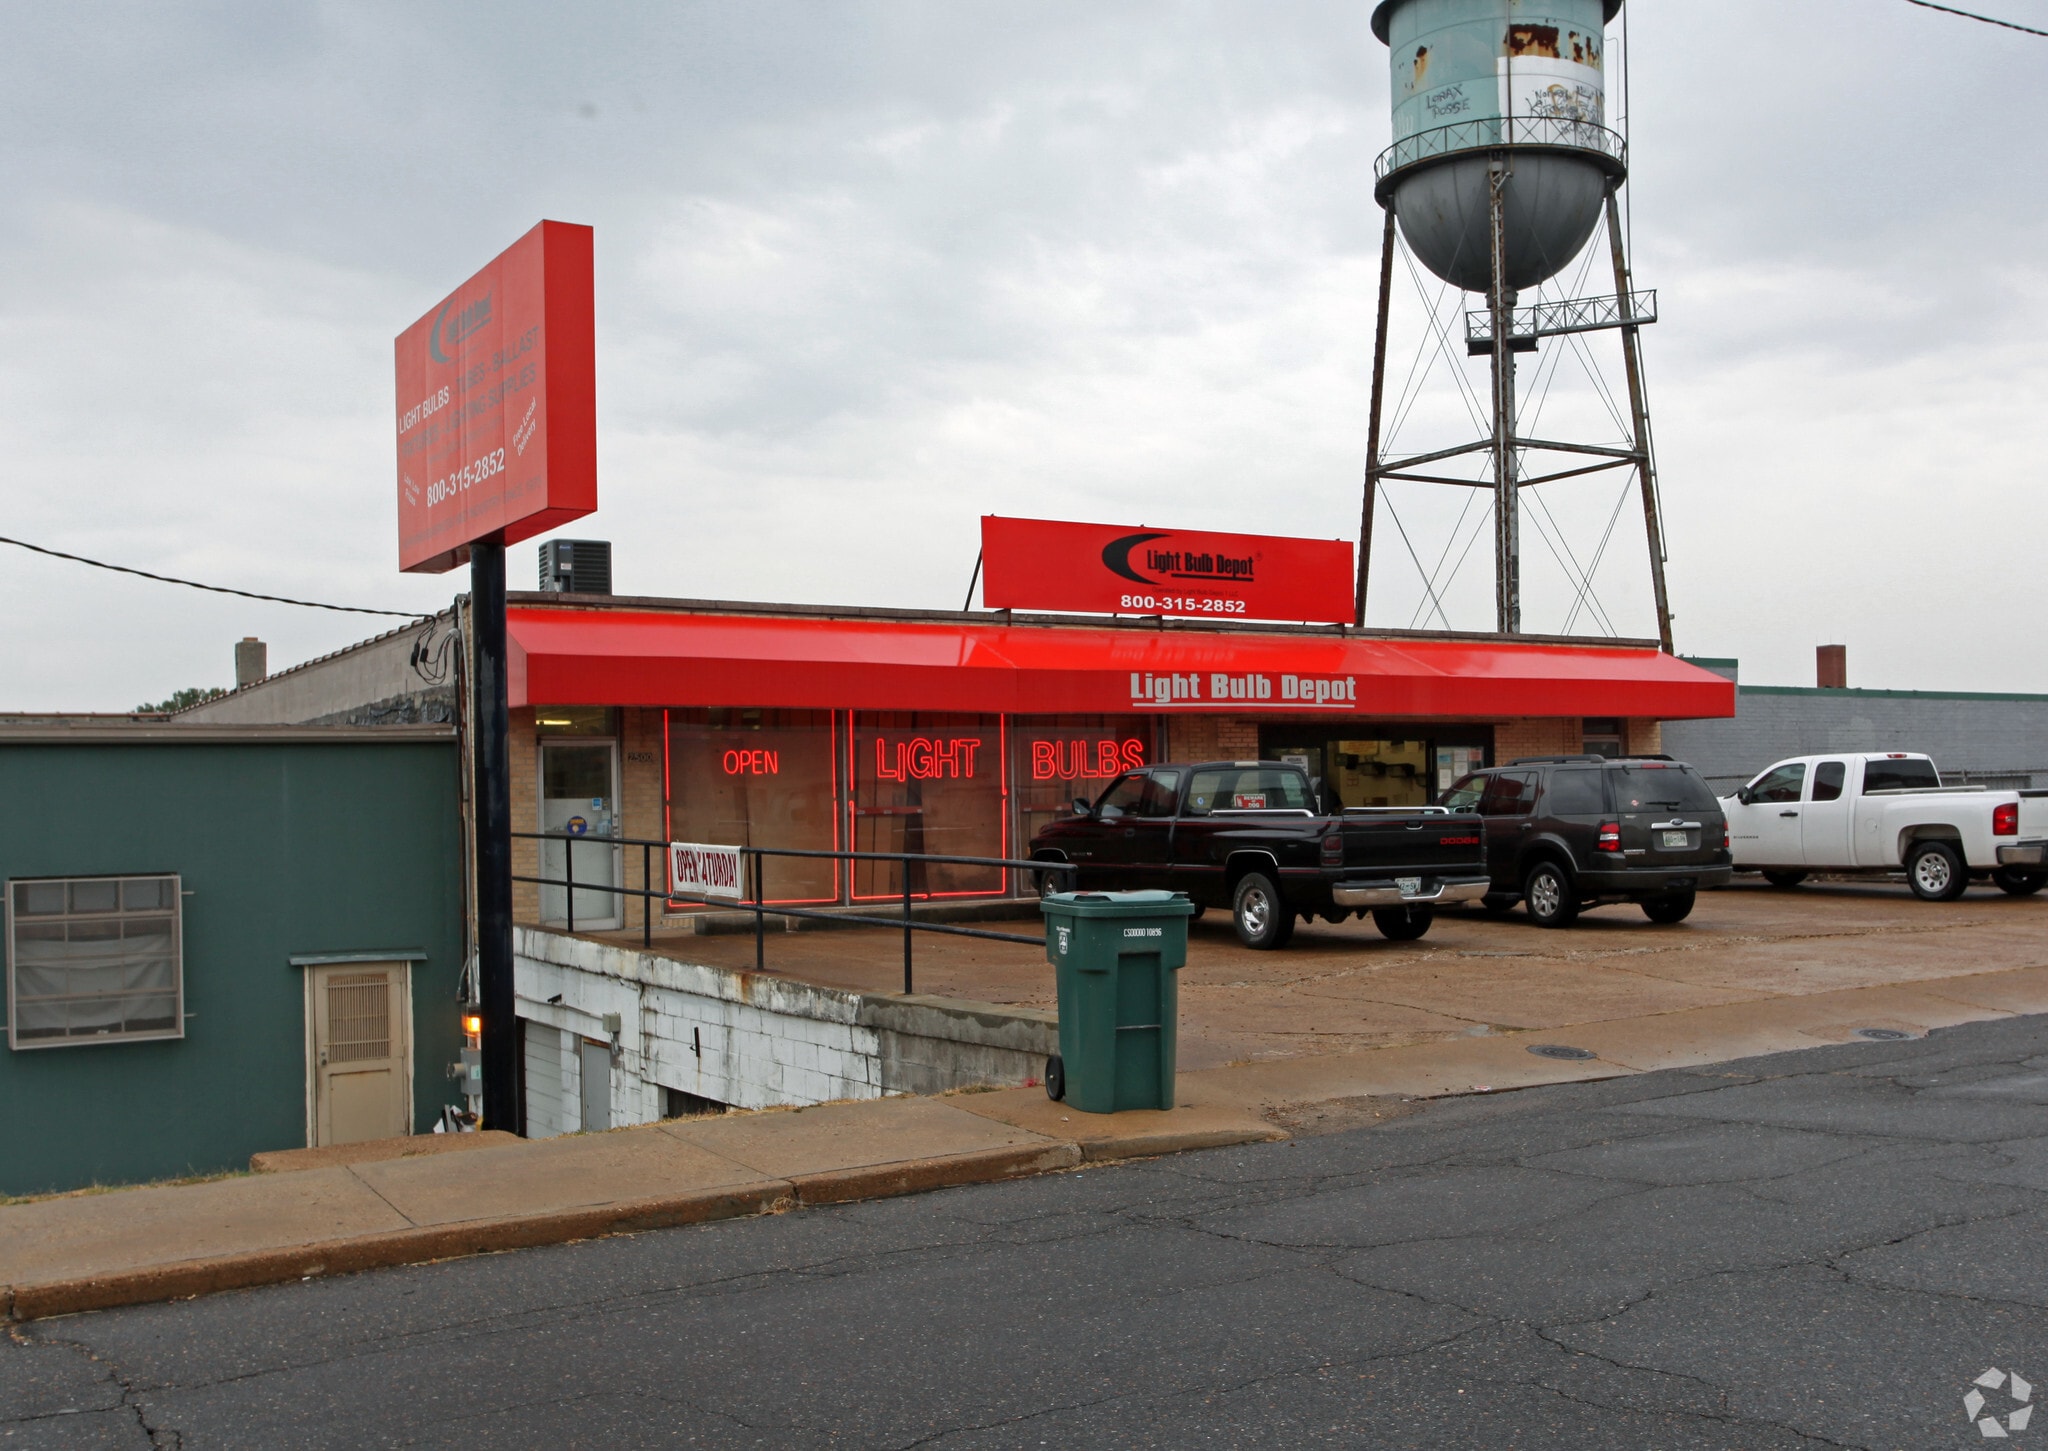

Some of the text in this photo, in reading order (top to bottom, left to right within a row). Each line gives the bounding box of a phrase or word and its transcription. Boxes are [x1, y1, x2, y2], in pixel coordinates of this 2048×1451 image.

[399, 405, 421, 434] LIGHT
[422, 385, 450, 419] BULBS
[492, 325, 538, 372] BALLAST
[513, 396, 536, 447] Free Local
[517, 419, 536, 456] Delivery
[427, 447, 505, 508] 800-315-2852
[1147, 548, 1254, 578] Light Bulb Depot
[1120, 594, 1246, 613] 800-315-2852
[1130, 672, 1356, 703] Light Bulb Depot
[723, 750, 779, 775] OPEN
[876, 738, 981, 782] LIGHT
[1032, 739, 1144, 781] BULBS
[1440, 837, 1479, 845] DODGE
[676, 849, 699, 883] OPEN
